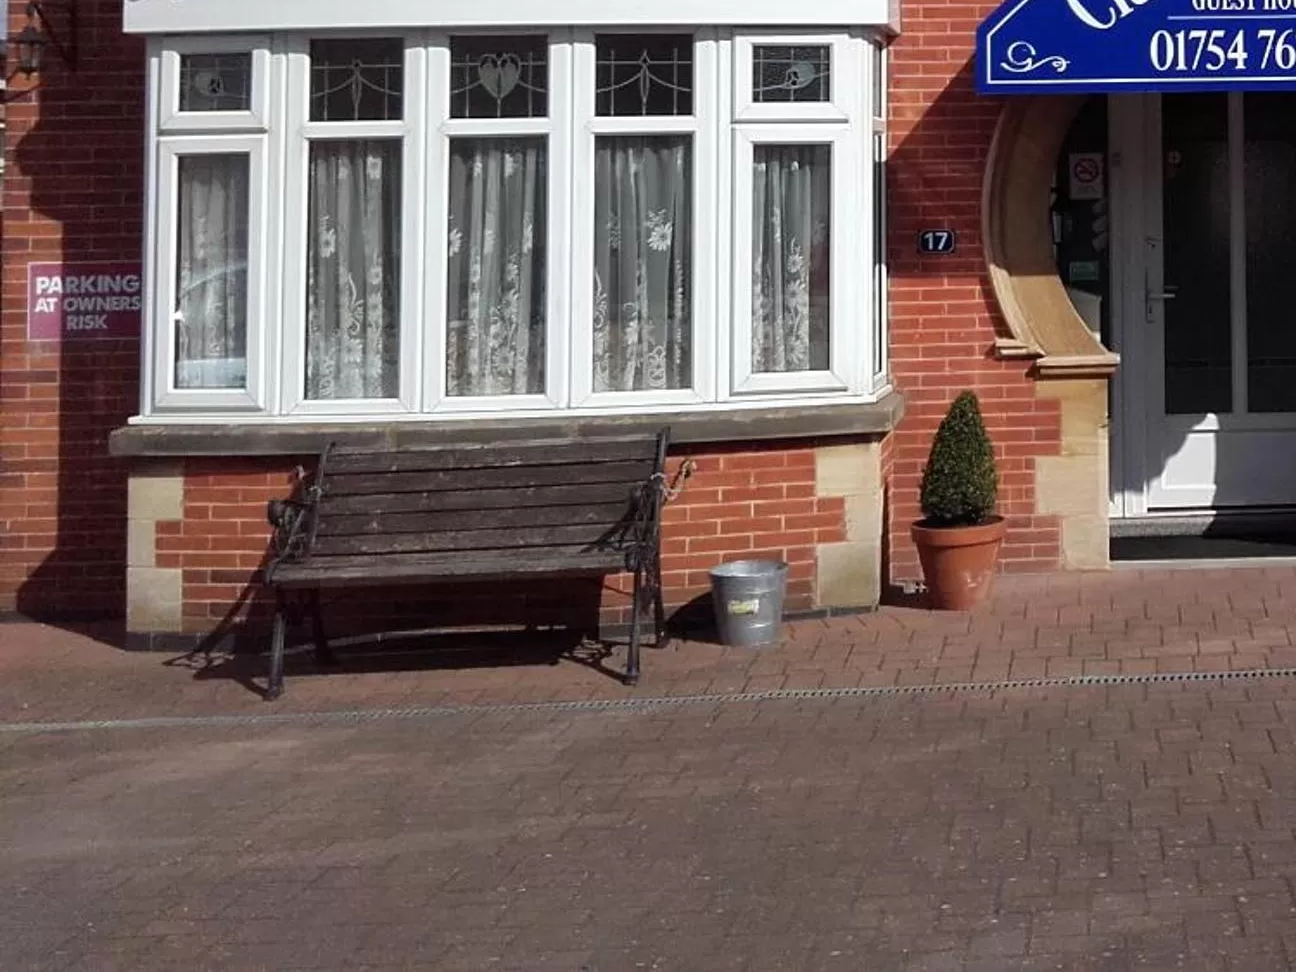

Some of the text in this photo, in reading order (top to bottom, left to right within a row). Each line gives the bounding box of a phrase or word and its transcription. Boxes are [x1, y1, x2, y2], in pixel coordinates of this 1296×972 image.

[1149, 30, 1248, 71] 01754
[924, 232, 948, 251] 17
[35, 275, 140, 294] PARKING
[35, 296, 141, 312] AT OWNERS
[66, 314, 108, 329] RISK
